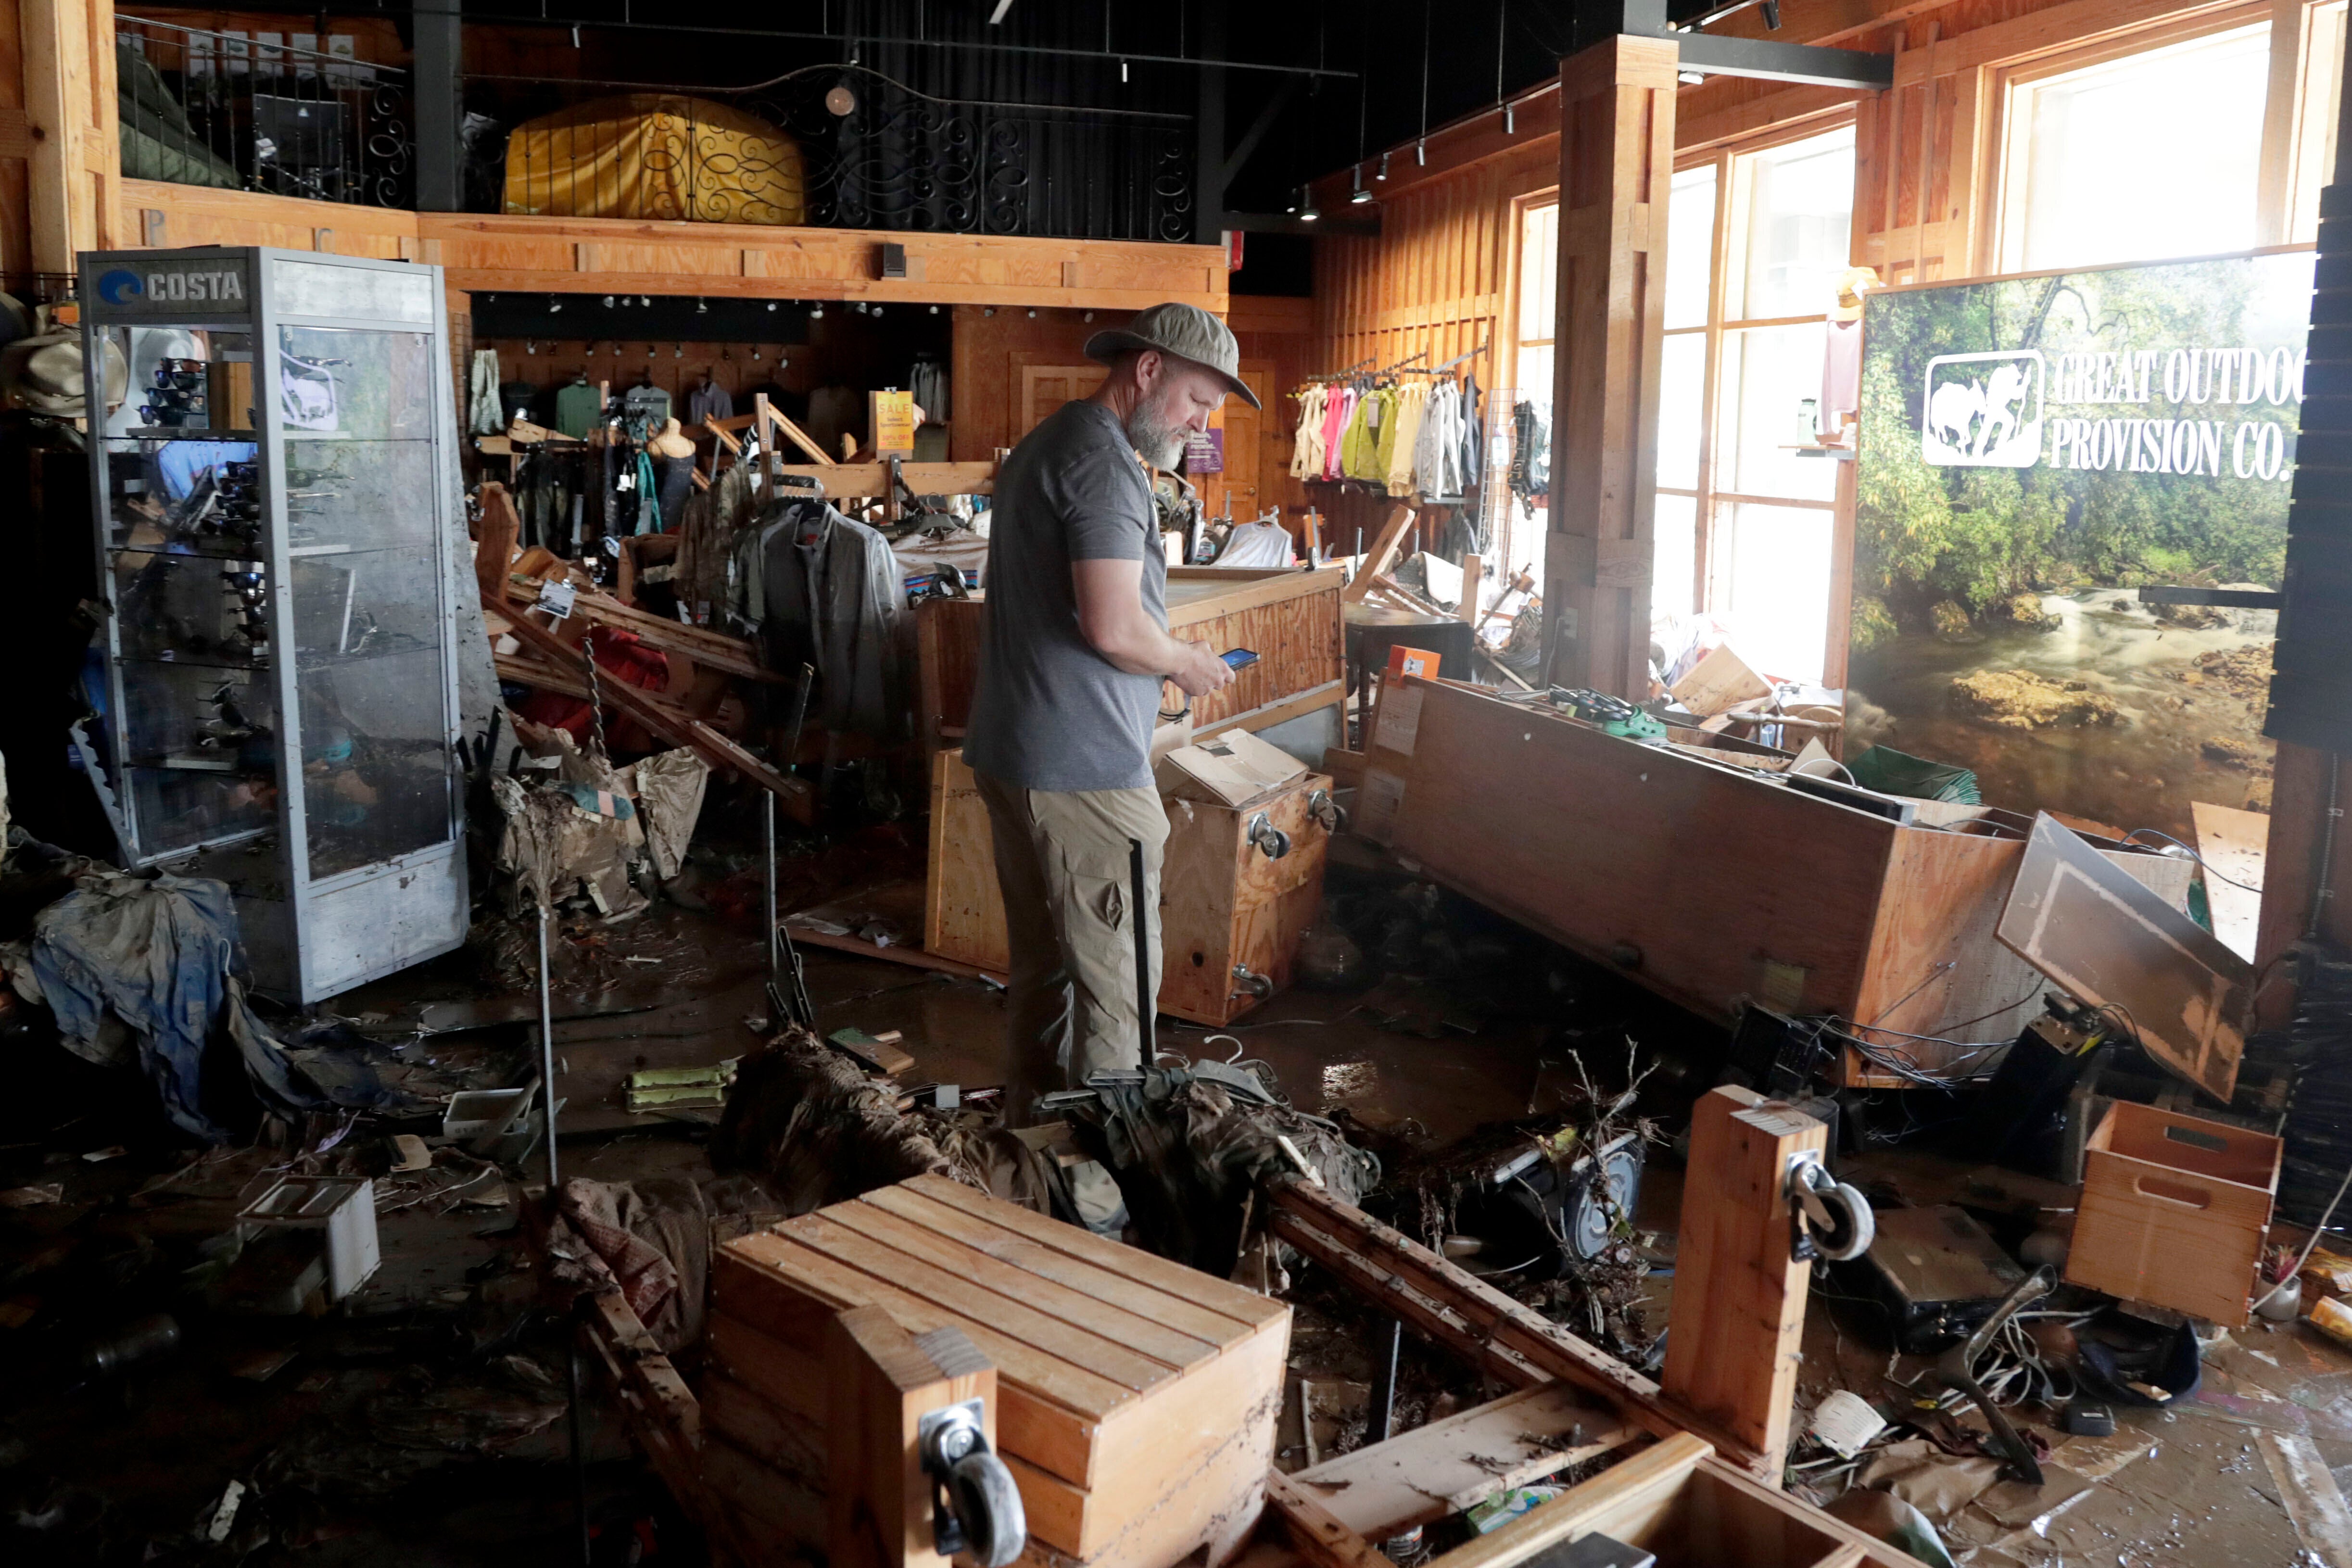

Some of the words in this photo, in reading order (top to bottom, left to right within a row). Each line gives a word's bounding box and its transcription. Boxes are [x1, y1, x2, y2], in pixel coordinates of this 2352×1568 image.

[147, 272, 242, 301] COSTA
[2054, 350, 2158, 404] GREAT
[879, 403, 910, 414] SALE
[2049, 418, 2225, 477] PROVISION
[2233, 421, 2290, 481] CO.
